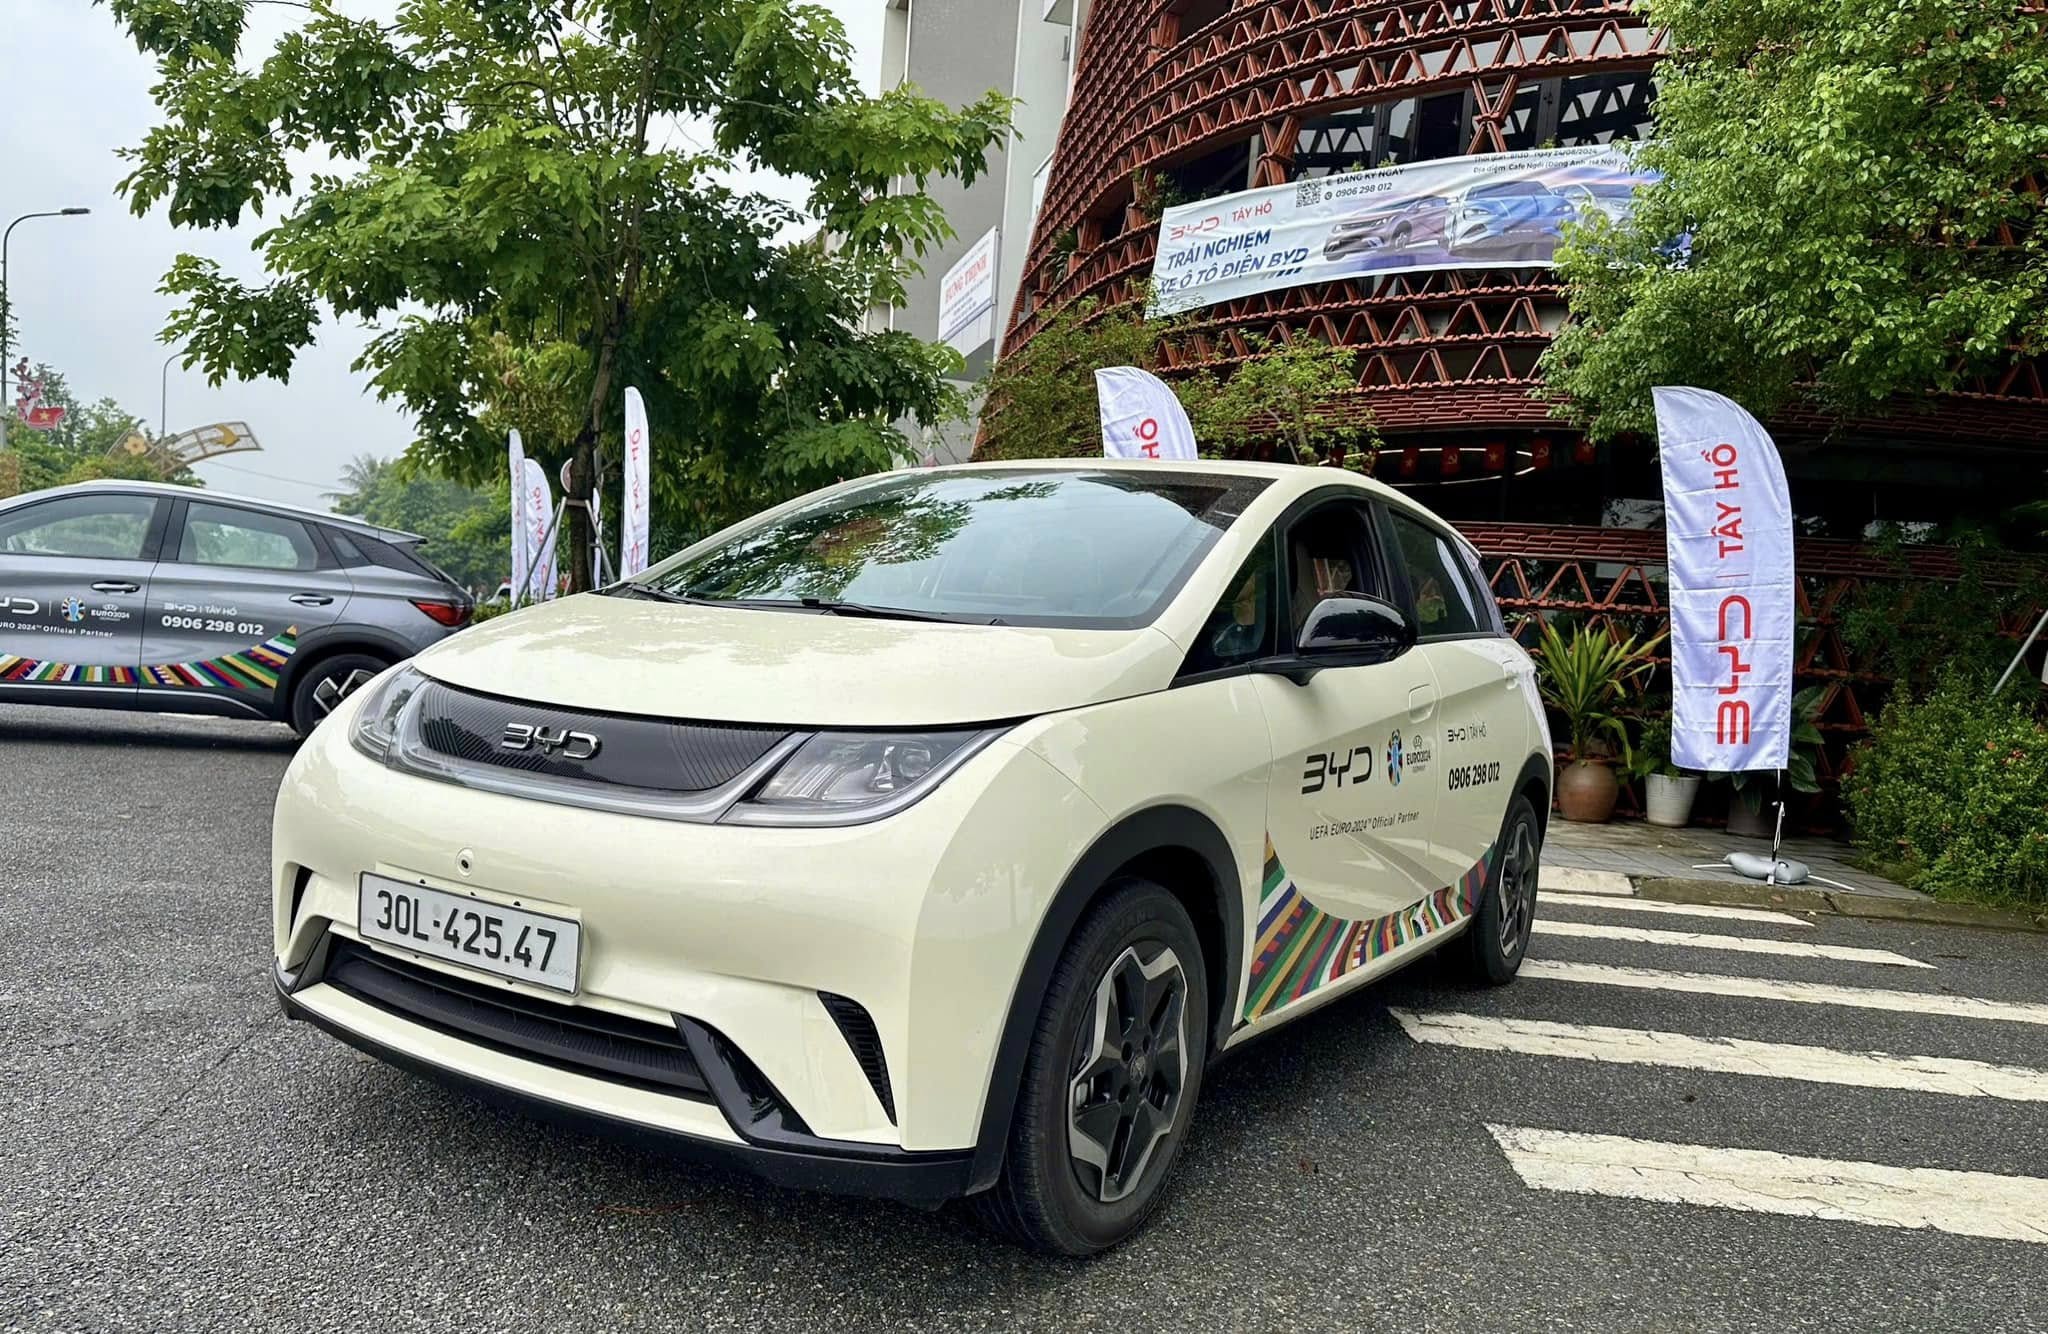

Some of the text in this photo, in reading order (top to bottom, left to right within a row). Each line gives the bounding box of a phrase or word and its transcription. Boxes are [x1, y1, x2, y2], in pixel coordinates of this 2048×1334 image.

[1335, 182, 1393, 198] 0906 298 012
[1167, 242, 1201, 270] TRẢI
[1180, 270, 1192, 289] Ô
[1196, 262, 1218, 284] TÔ
[1221, 252, 1266, 278] ĐIỆN
[1267, 247, 1309, 269] BYD
[1700, 443, 1752, 745] BYD TÂY HỒ
[43, 625, 76, 635] Official
[80, 628, 113, 638] Partner
[161, 615, 264, 636] 0906 298 012
[501, 722, 601, 760] BYD
[1447, 727, 1466, 742] BYD
[1301, 746, 1373, 795] BYD
[1448, 765, 1471, 791] 0906
[1471, 763, 1487, 787] 298
[1487, 761, 1500, 783] 012
[1309, 825, 1329, 841] UEFA
[1330, 822, 1352, 836] EURO
[1372, 814, 1396, 830] Official
[1398, 810, 1420, 824] Partner
